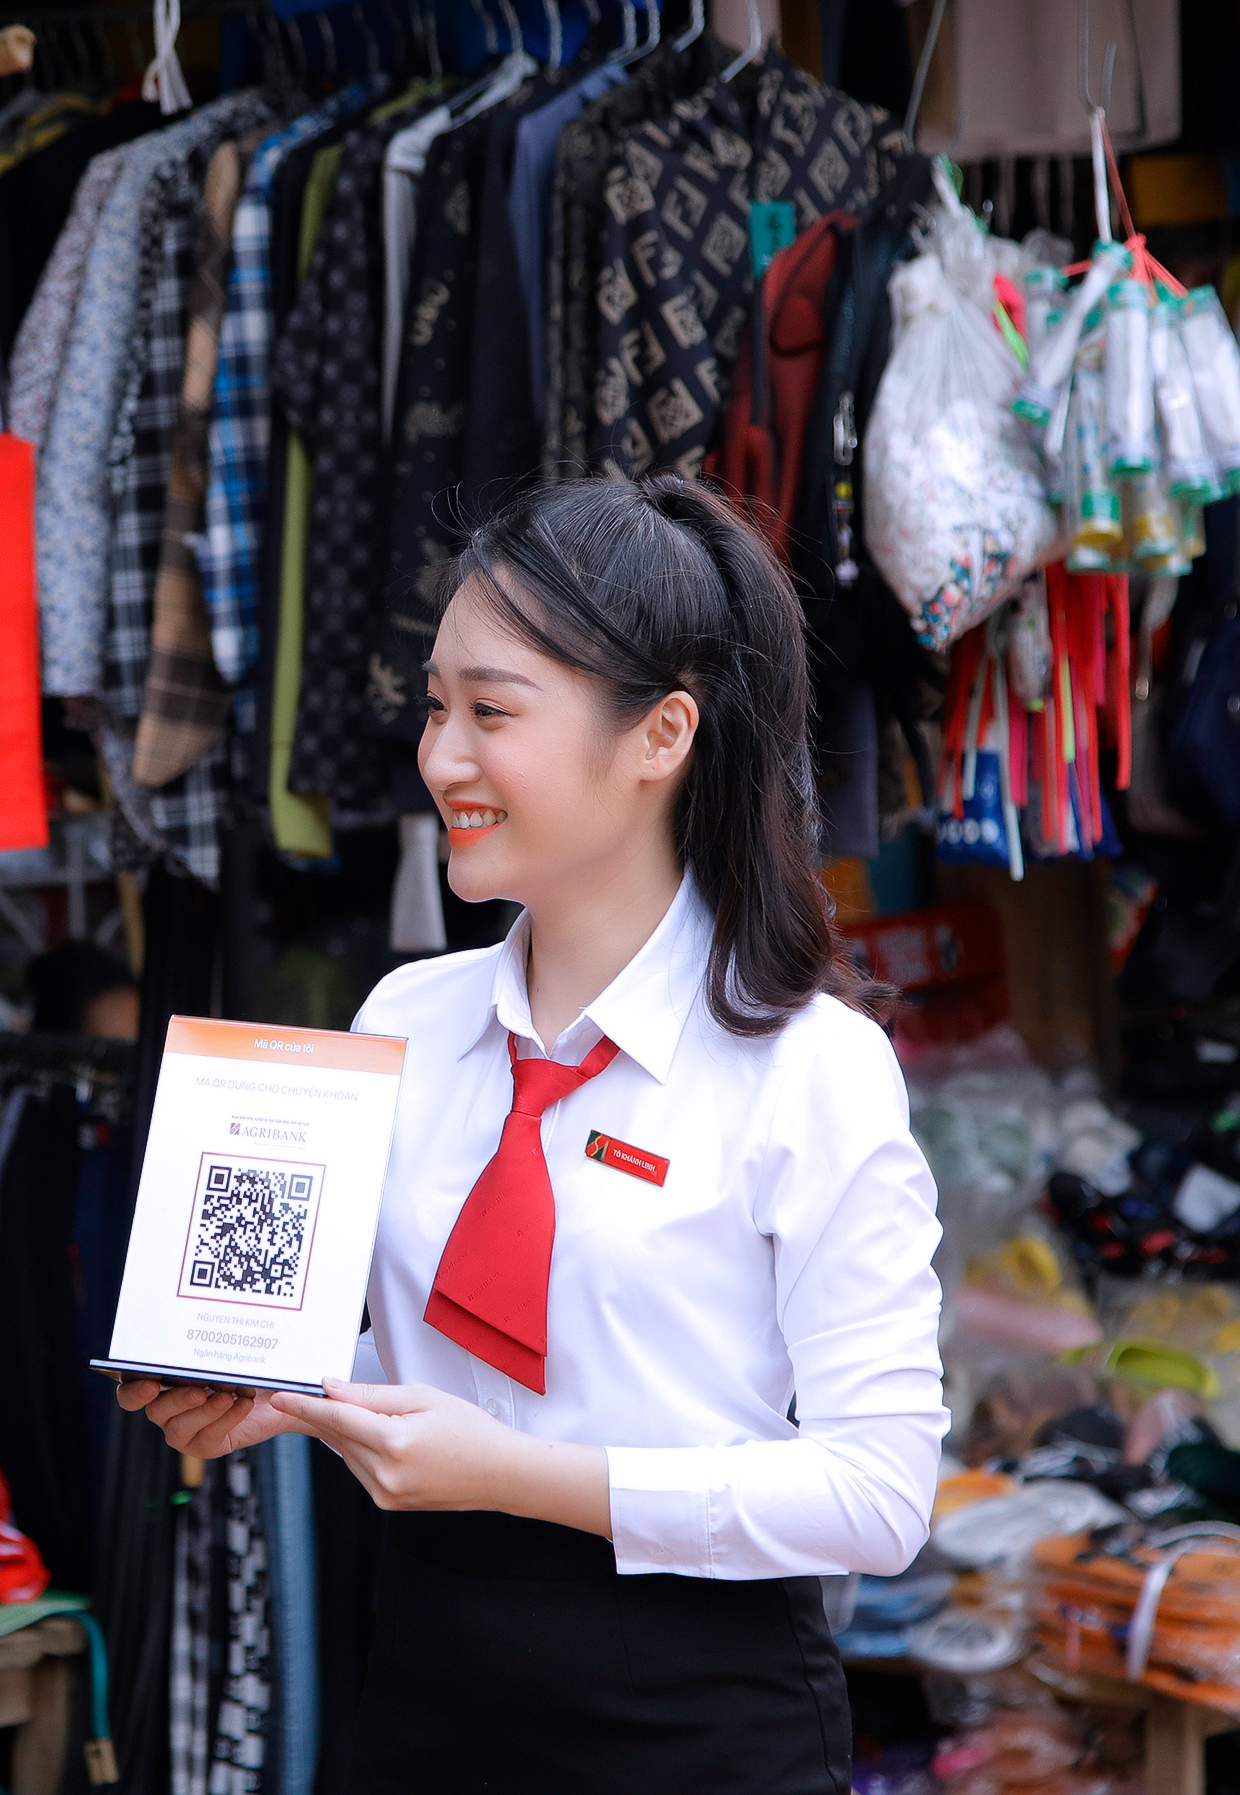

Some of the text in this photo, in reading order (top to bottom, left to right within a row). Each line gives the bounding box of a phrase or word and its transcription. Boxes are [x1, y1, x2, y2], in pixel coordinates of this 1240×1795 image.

[253, 1038, 315, 1054] Mã QR của tôi
[212, 1078, 227, 1088] QR
[257, 1082, 280, 1094] CHO
[241, 1126, 307, 1143] AGRIBANK
[641, 1160, 656, 1172] LINH
[196, 1312, 275, 1330] NGUYEN THI KIM CHI
[186, 1328, 279, 1350] 8700205162907
[233, 1352, 266, 1365] Agribank
